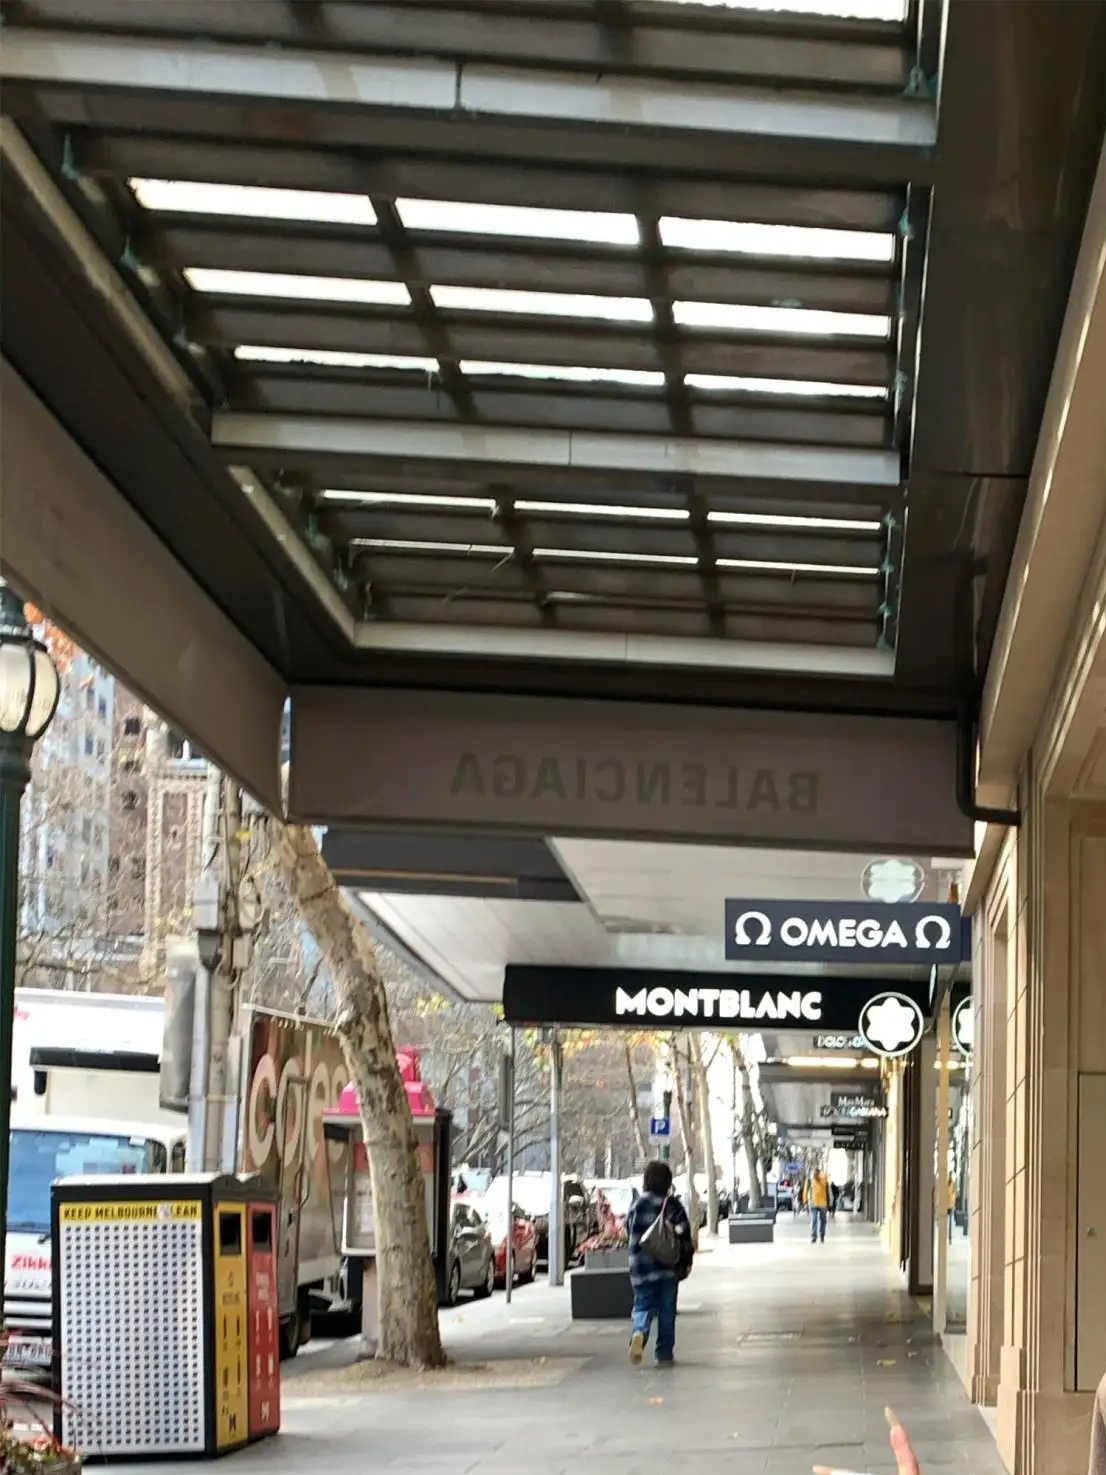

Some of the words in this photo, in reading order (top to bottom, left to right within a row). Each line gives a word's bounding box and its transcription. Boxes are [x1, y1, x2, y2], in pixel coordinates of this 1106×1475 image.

[780, 917, 908, 949] OMEGA
[615, 986, 822, 1021] MONTBLANC
[63, 1207, 92, 1221] KEEP
[170, 1204, 198, 1219] LEAN
